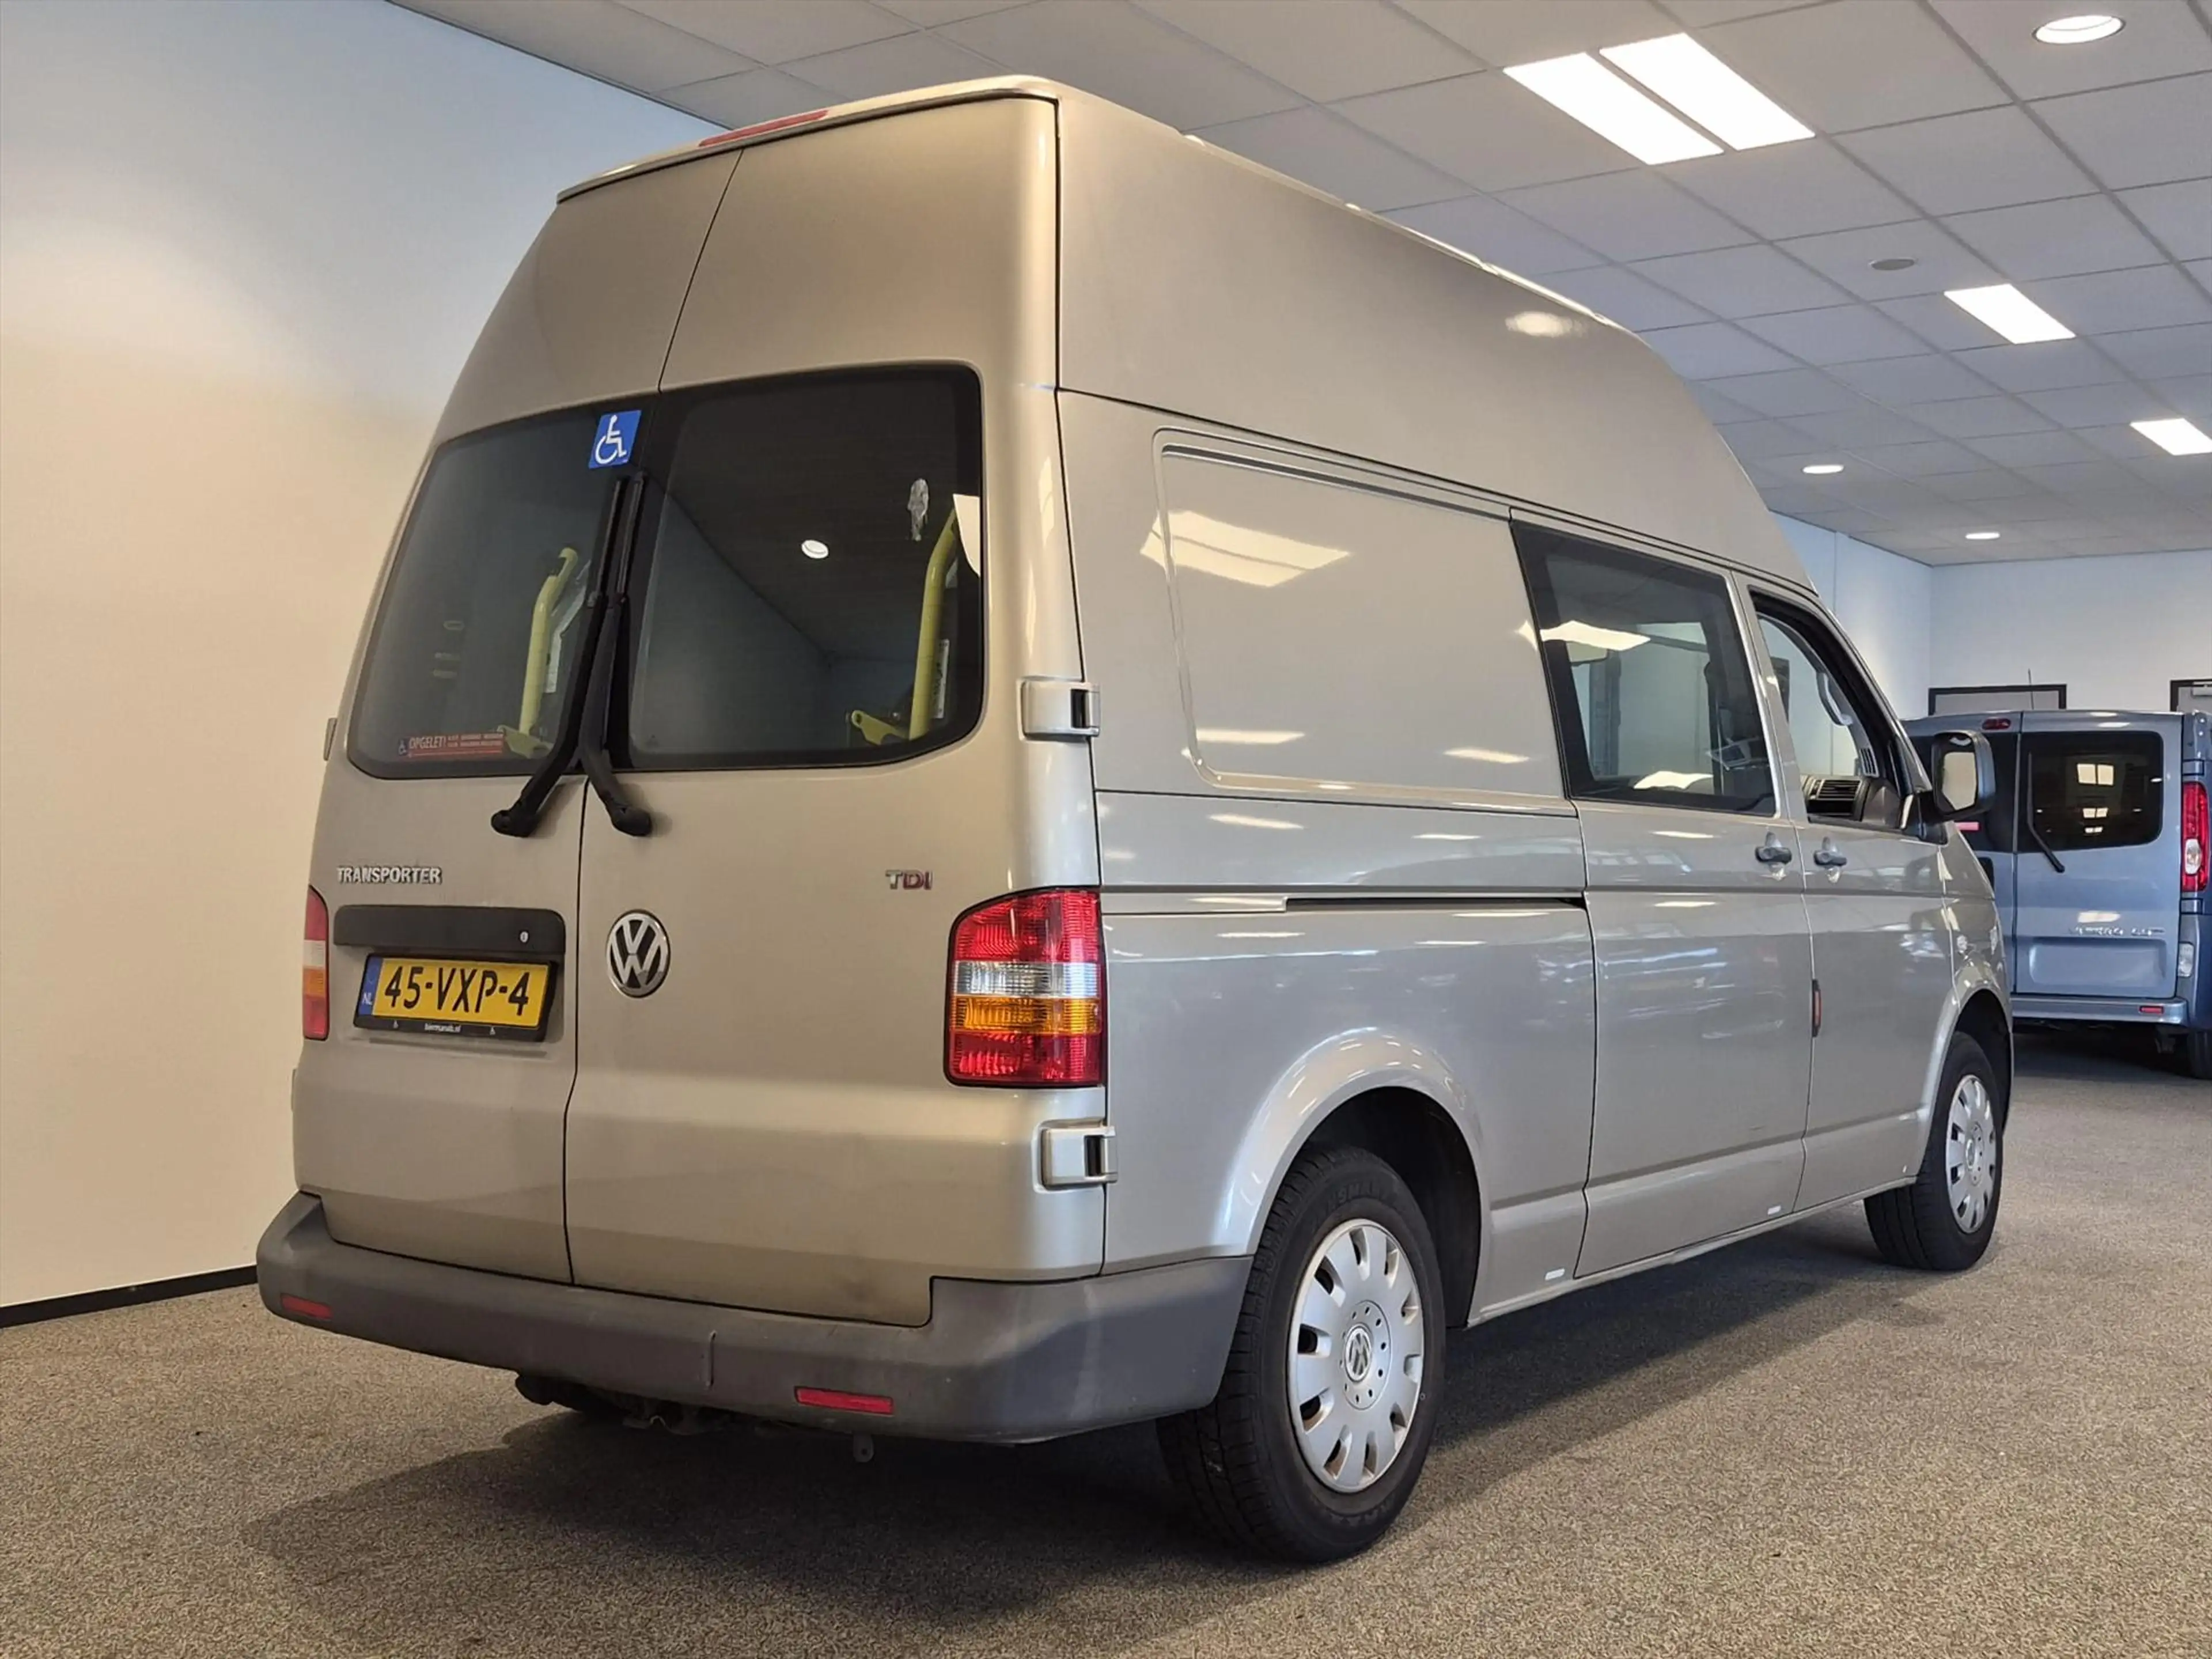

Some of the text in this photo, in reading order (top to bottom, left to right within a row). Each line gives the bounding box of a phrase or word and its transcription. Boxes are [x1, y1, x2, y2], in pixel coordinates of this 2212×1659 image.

[336, 866, 442, 884] TRANSPORTER
[885, 869, 933, 890] TDI
[361, 991, 373, 1006] NL
[384, 966, 530, 1016] 45-VXP-4
